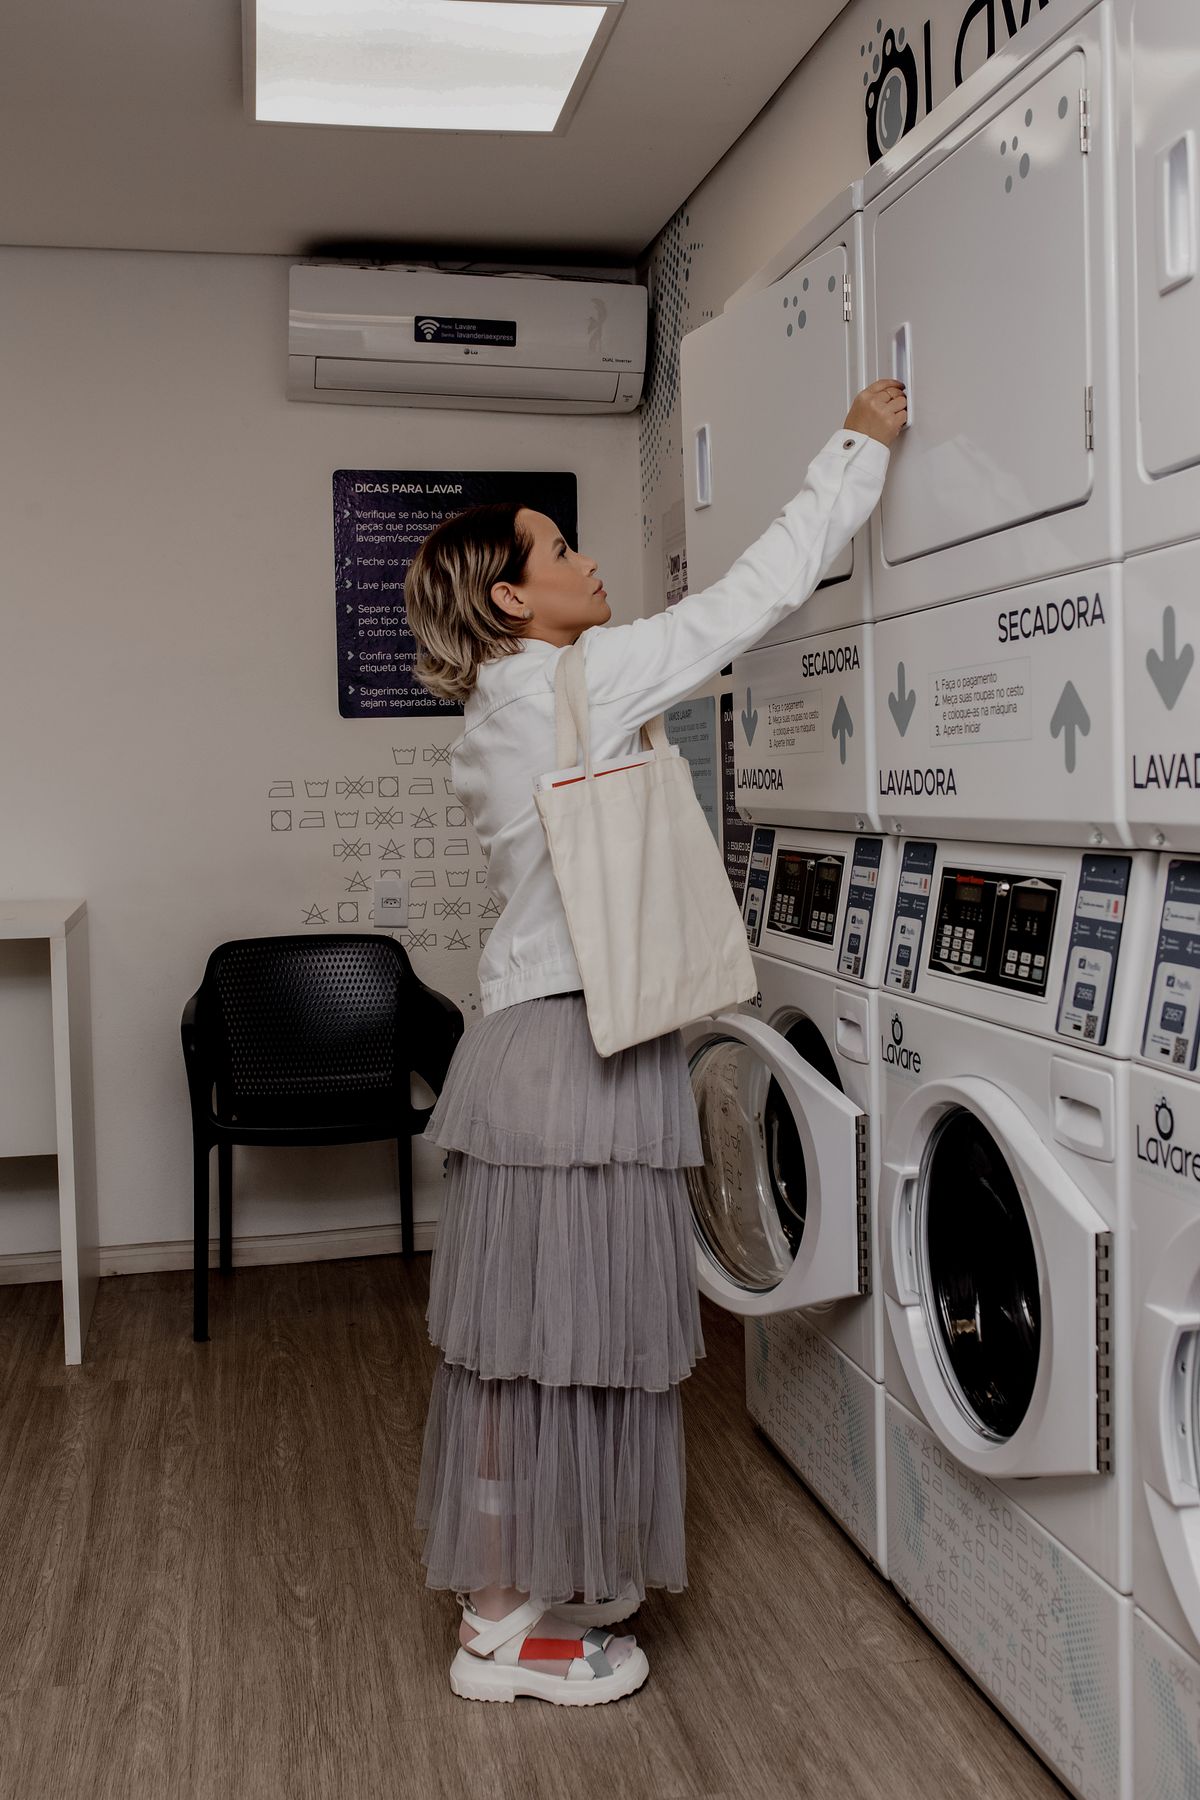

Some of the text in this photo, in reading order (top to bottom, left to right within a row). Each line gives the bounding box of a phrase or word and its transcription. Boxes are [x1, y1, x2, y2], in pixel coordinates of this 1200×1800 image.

[454, 323, 477, 331] Lavare
[456, 332, 514, 341] lavanderiaexpress
[355, 484, 463, 494] DICAS PARA LAVAR
[356, 510, 396, 520] Verifique
[411, 510, 429, 518] não
[431, 510, 443, 518] há
[356, 523, 384, 533] peças
[386, 524, 404, 532] que
[356, 558, 385, 566] Feche
[357, 581, 405, 592] Lave jeans
[358, 604, 390, 614] Separe
[358, 616, 378, 626] pelo
[380, 617, 398, 626] tipo
[998, 592, 1106, 644] SECADORA
[367, 629, 396, 637] outros
[359, 652, 392, 660] Confira
[802, 644, 860, 678] SECADORA
[360, 664, 397, 674] etiqueta
[399, 664, 411, 672] da
[935, 673, 998, 692] 1. Faça o pagamento
[360, 686, 429, 697] Sugerimos que
[934, 684, 1024, 708] 2. Meça suas roupas no cesto
[360, 699, 388, 708] sejam
[390, 698, 437, 708] separadas
[438, 697, 456, 706] das
[942, 702, 1018, 720] e coloque-as na máquina
[936, 724, 940, 736] 3.
[943, 723, 963, 738] Aperte
[737, 768, 784, 790] LAVADORA
[879, 768, 957, 796] LAVADORA
[880, 1034, 922, 1074] Lavare
[1136, 1124, 1200, 1182] Lavare
